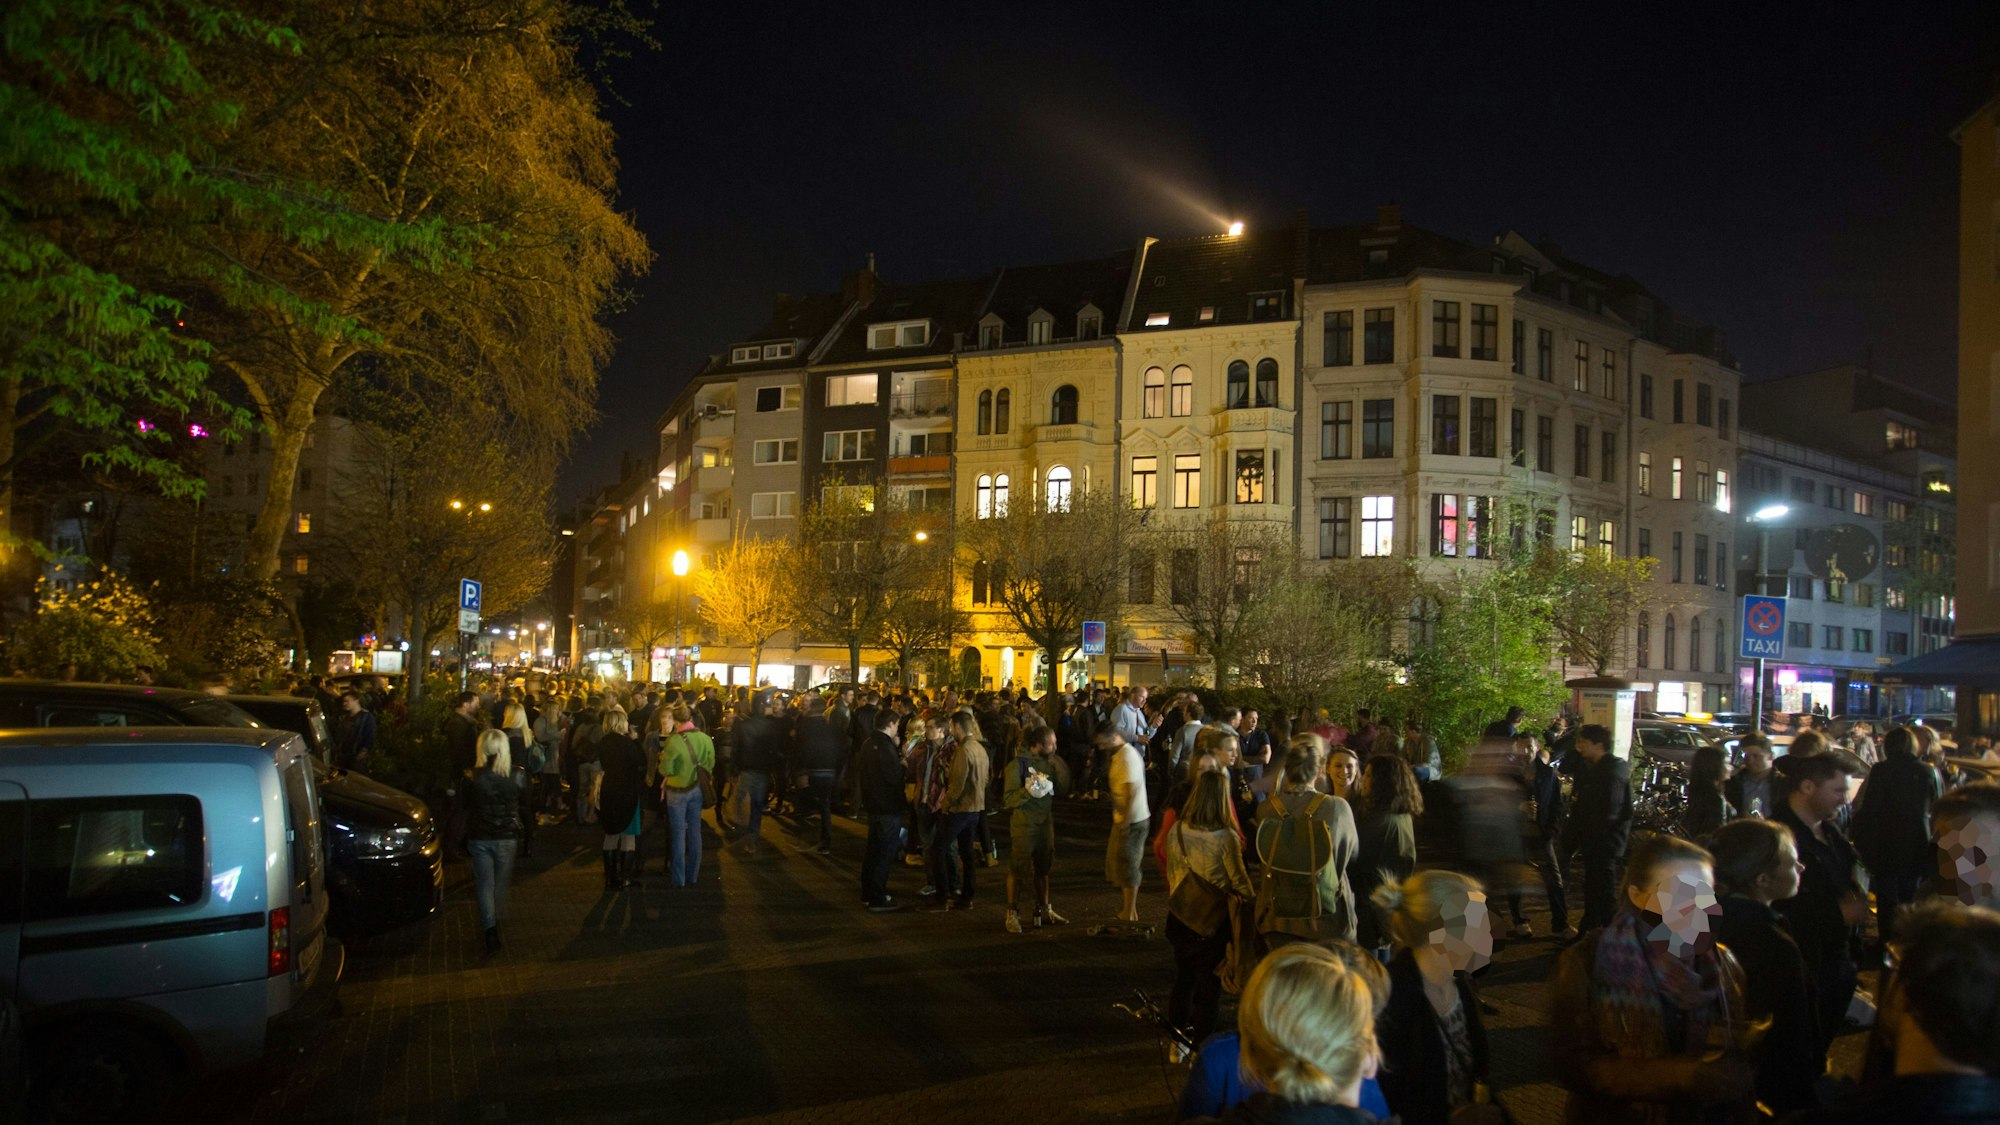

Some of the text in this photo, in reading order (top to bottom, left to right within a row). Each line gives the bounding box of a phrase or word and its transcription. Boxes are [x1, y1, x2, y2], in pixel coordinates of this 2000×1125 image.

[465, 583, 477, 606] P
[1085, 643, 1103, 652] TAXI
[1745, 638, 1780, 654] TAXI
